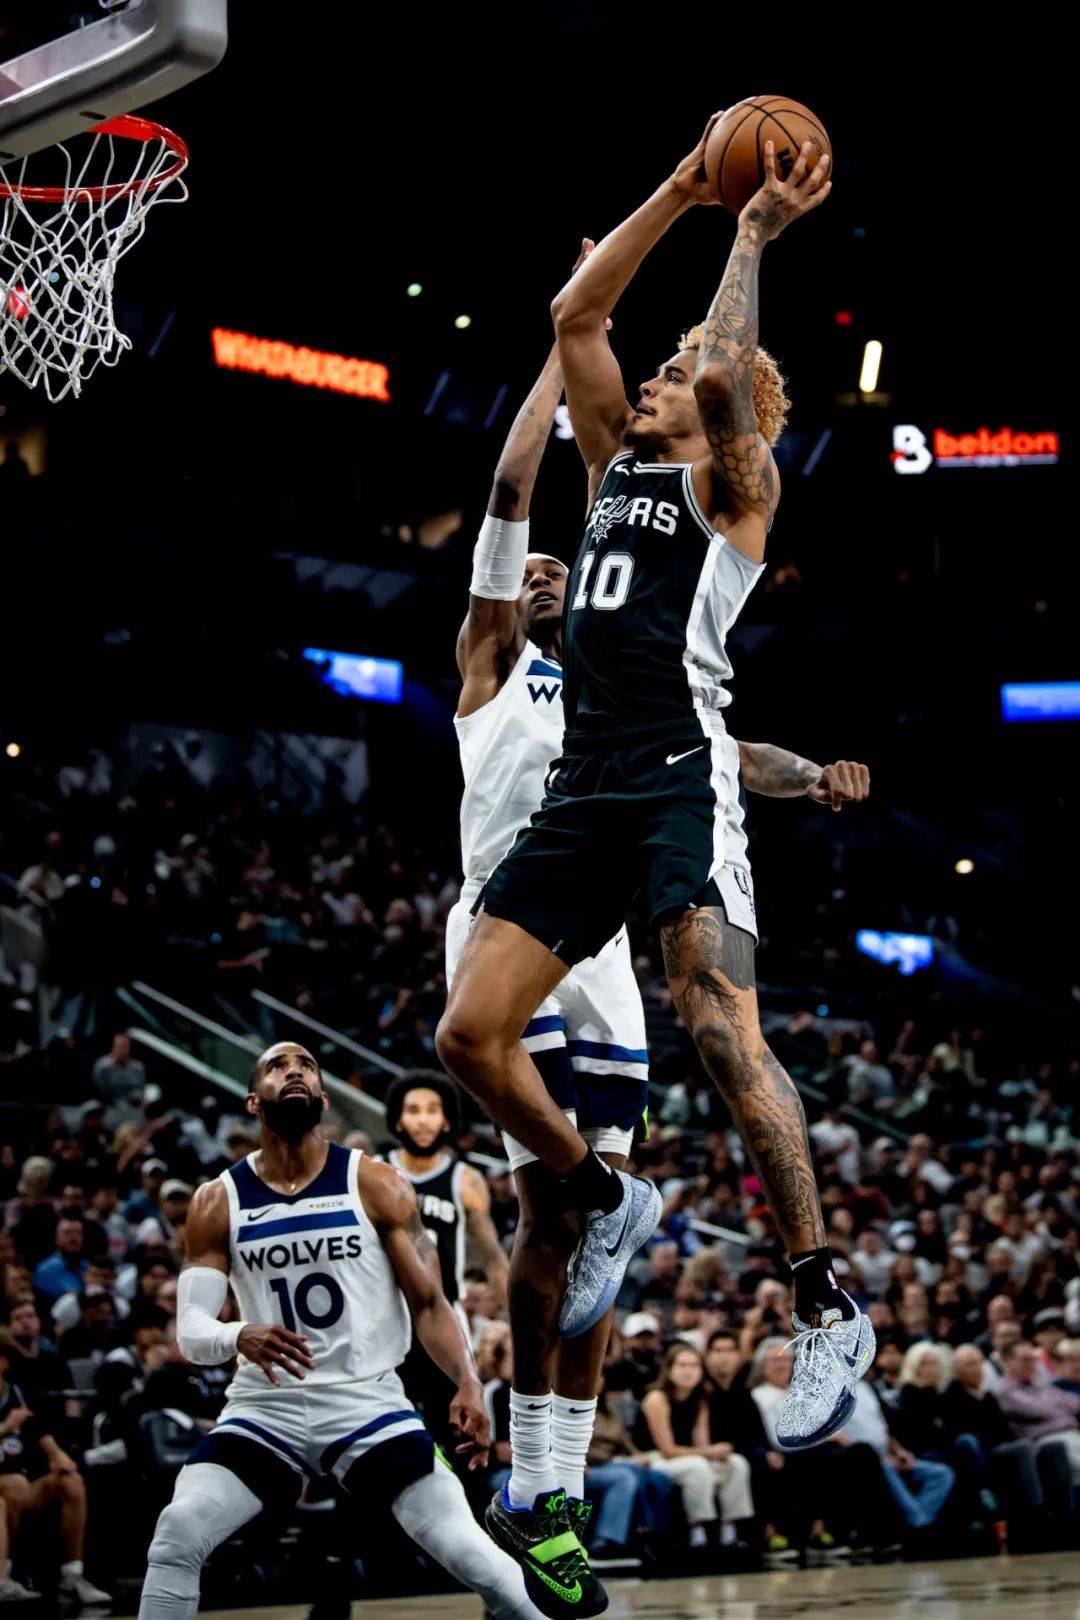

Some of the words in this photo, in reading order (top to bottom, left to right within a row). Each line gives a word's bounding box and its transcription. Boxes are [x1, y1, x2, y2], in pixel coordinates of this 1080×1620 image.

[933, 426, 1059, 455] beldon
[572, 551, 635, 610] 10
[240, 1235, 362, 1272] WOLVES
[269, 1272, 345, 1334] 10
